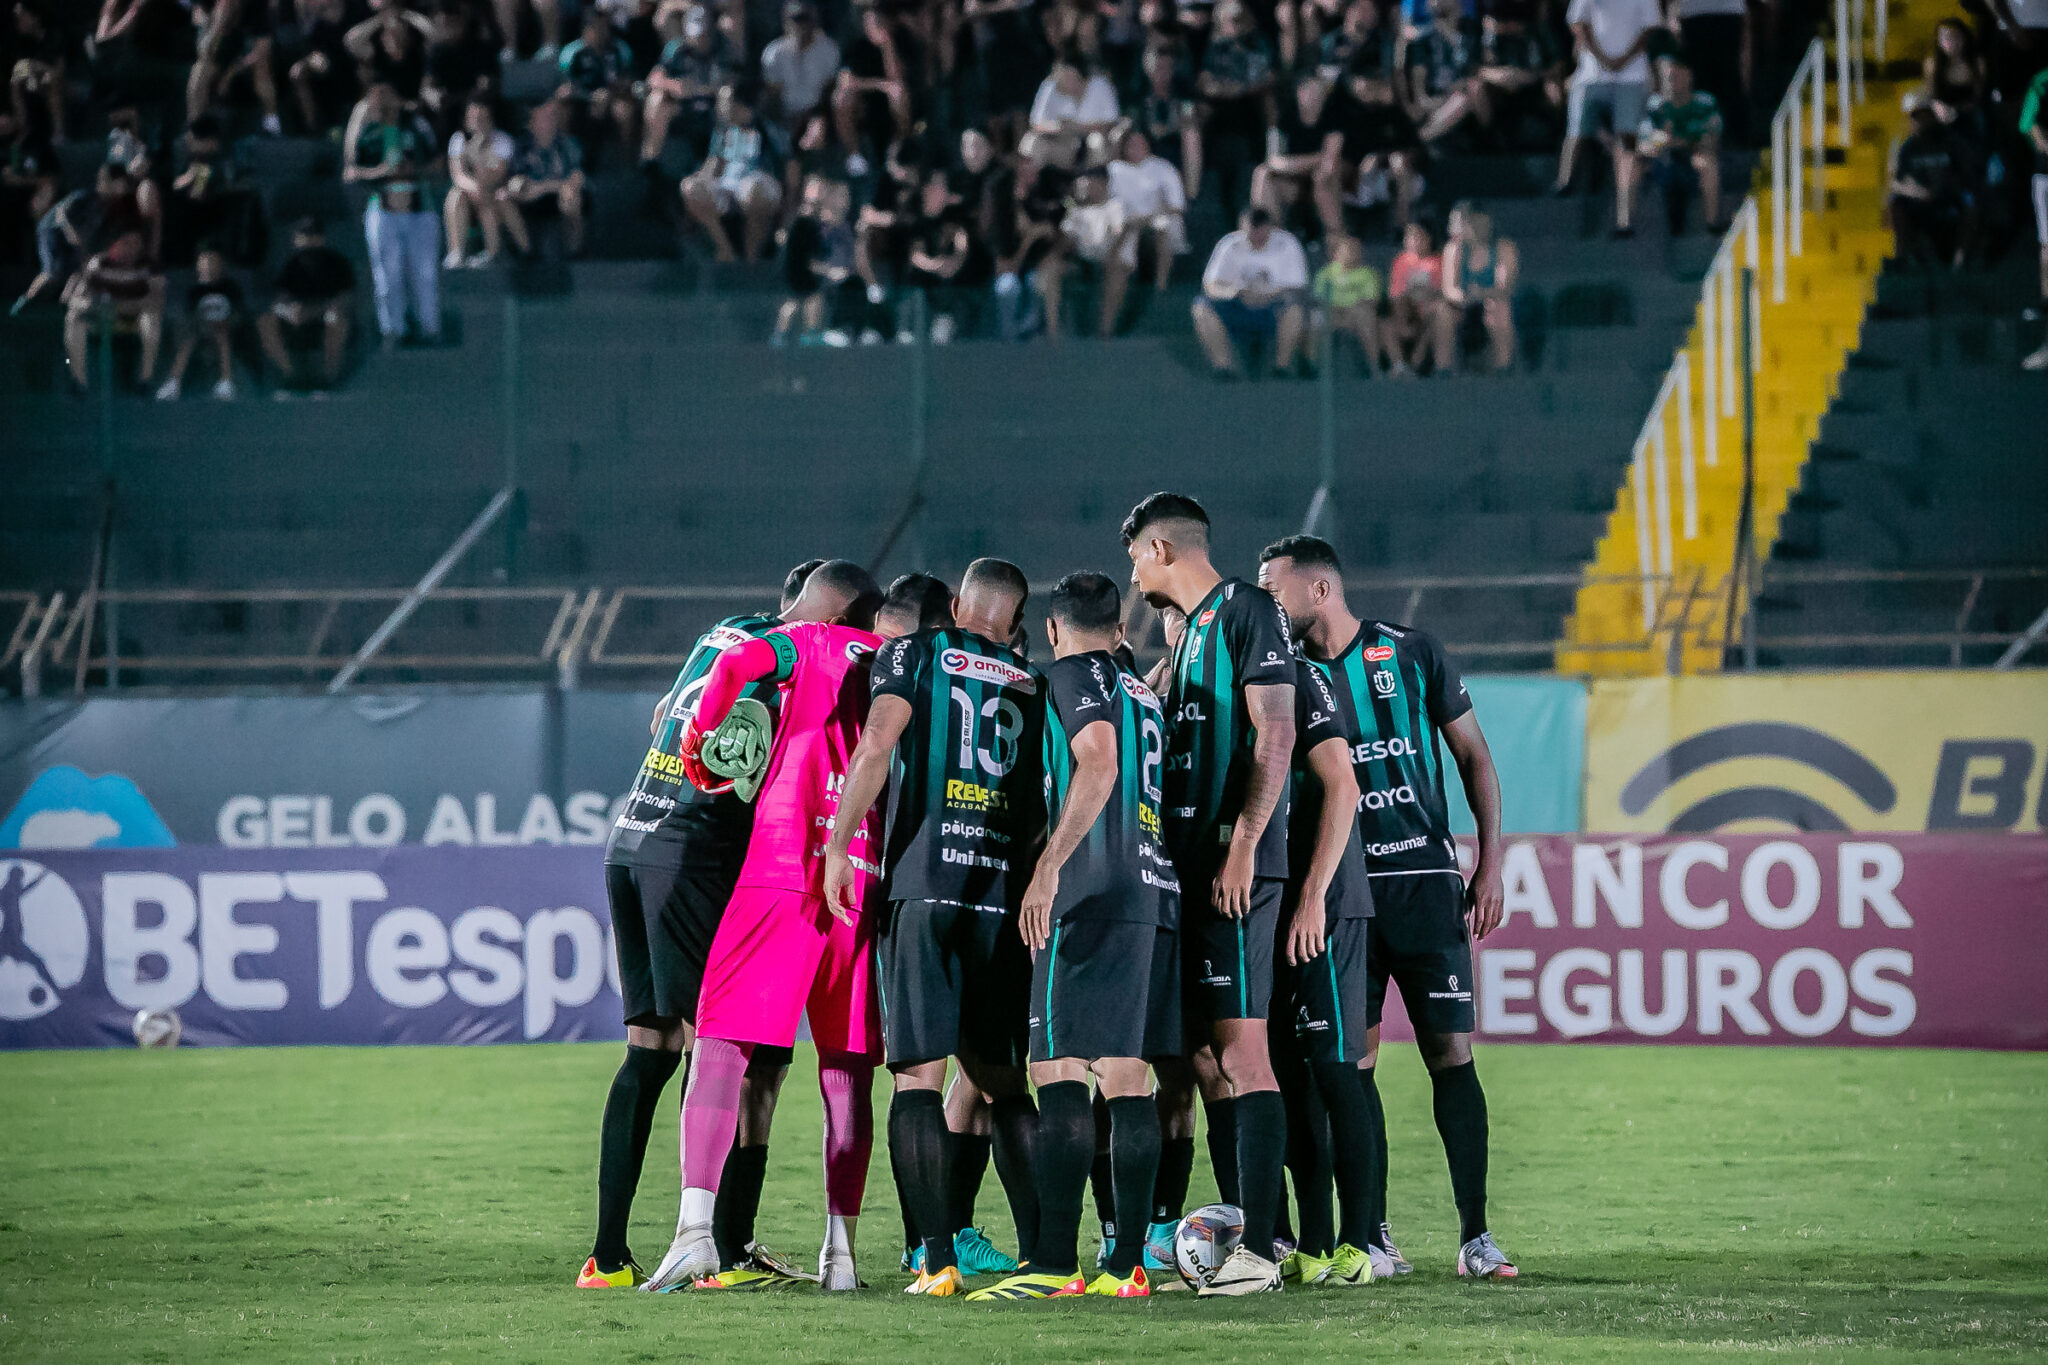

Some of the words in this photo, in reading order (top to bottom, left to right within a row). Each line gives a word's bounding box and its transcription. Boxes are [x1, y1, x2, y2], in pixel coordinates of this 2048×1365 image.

[951, 686, 1024, 777] 13
[1348, 737, 1417, 765] RESOL
[217, 793, 406, 848] GELO
[1364, 835, 1428, 857] iCesumar
[1456, 841, 1914, 931] ANCOR
[102, 871, 622, 1041] BETesp
[1479, 948, 1917, 1038] EGUROS
